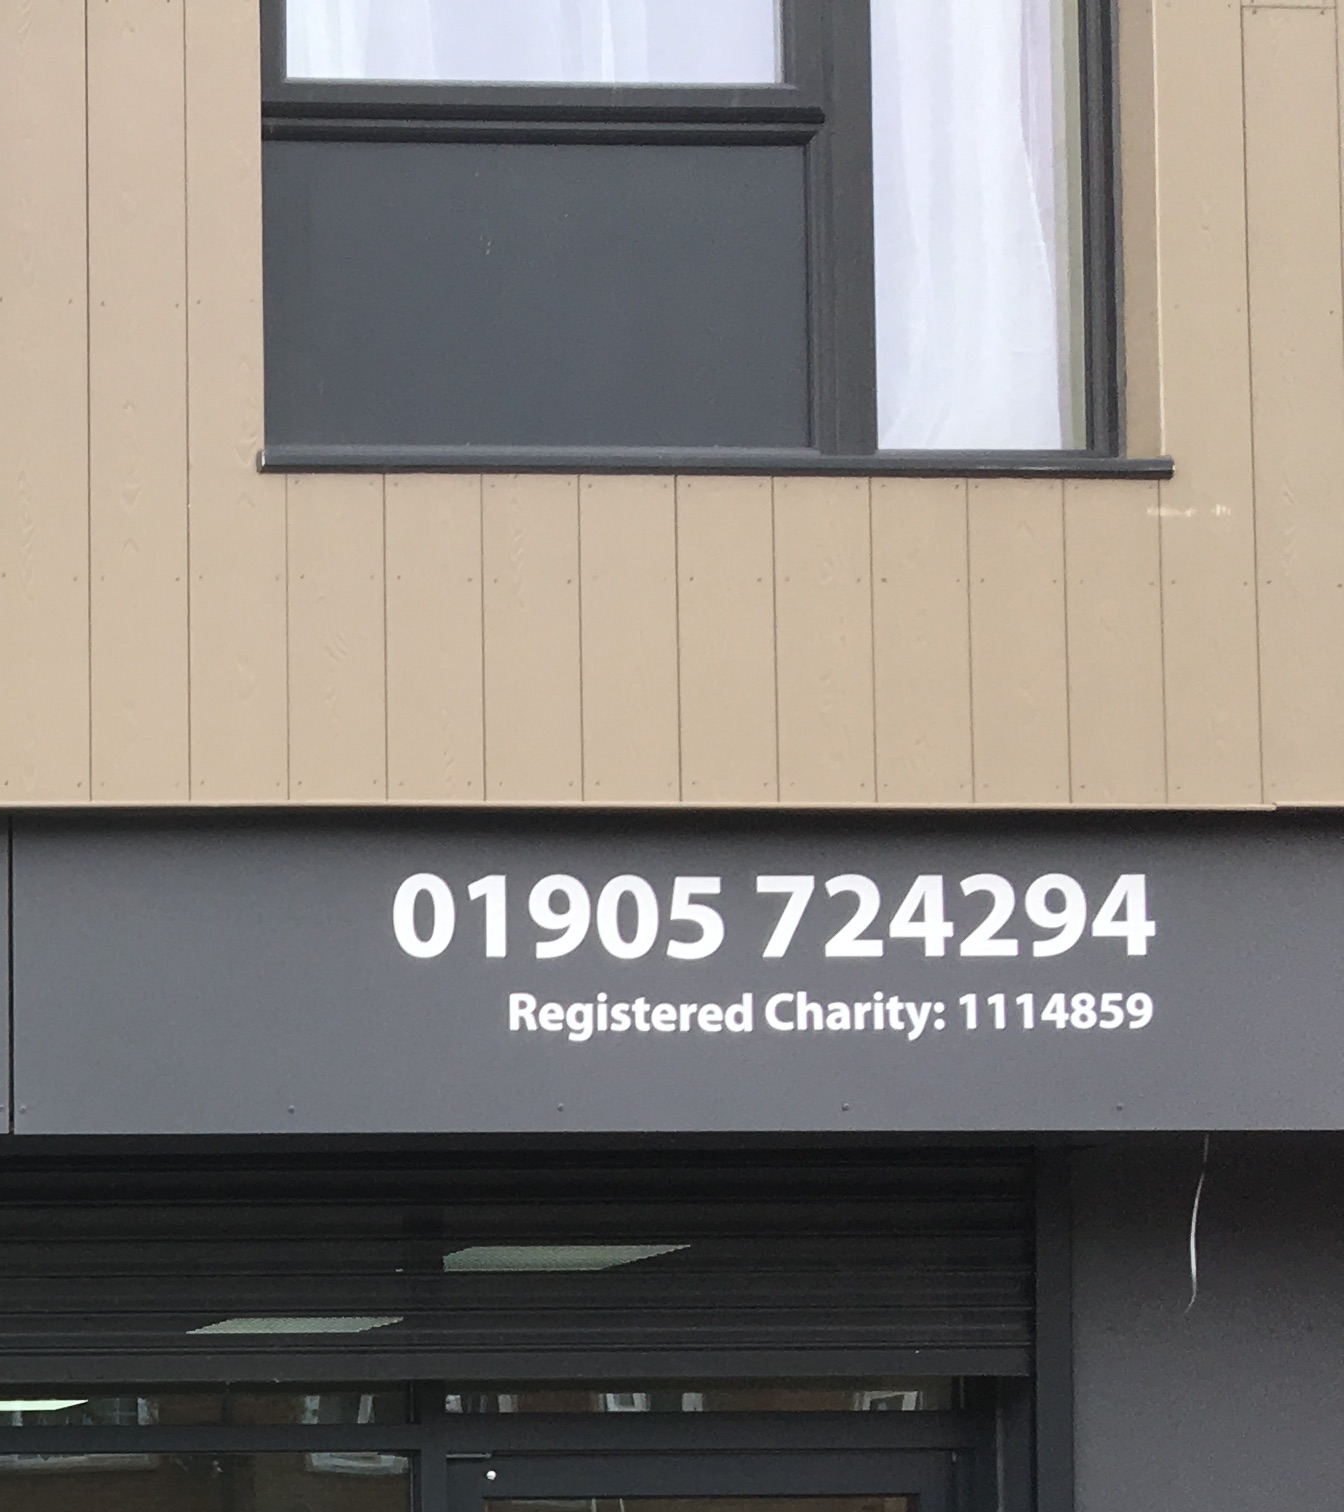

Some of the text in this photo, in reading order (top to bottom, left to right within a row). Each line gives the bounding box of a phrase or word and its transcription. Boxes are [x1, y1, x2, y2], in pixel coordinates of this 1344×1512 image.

[392, 873, 1157, 960] 01905 724294
[509, 992, 1154, 1041] Registered Charity: 1114859
